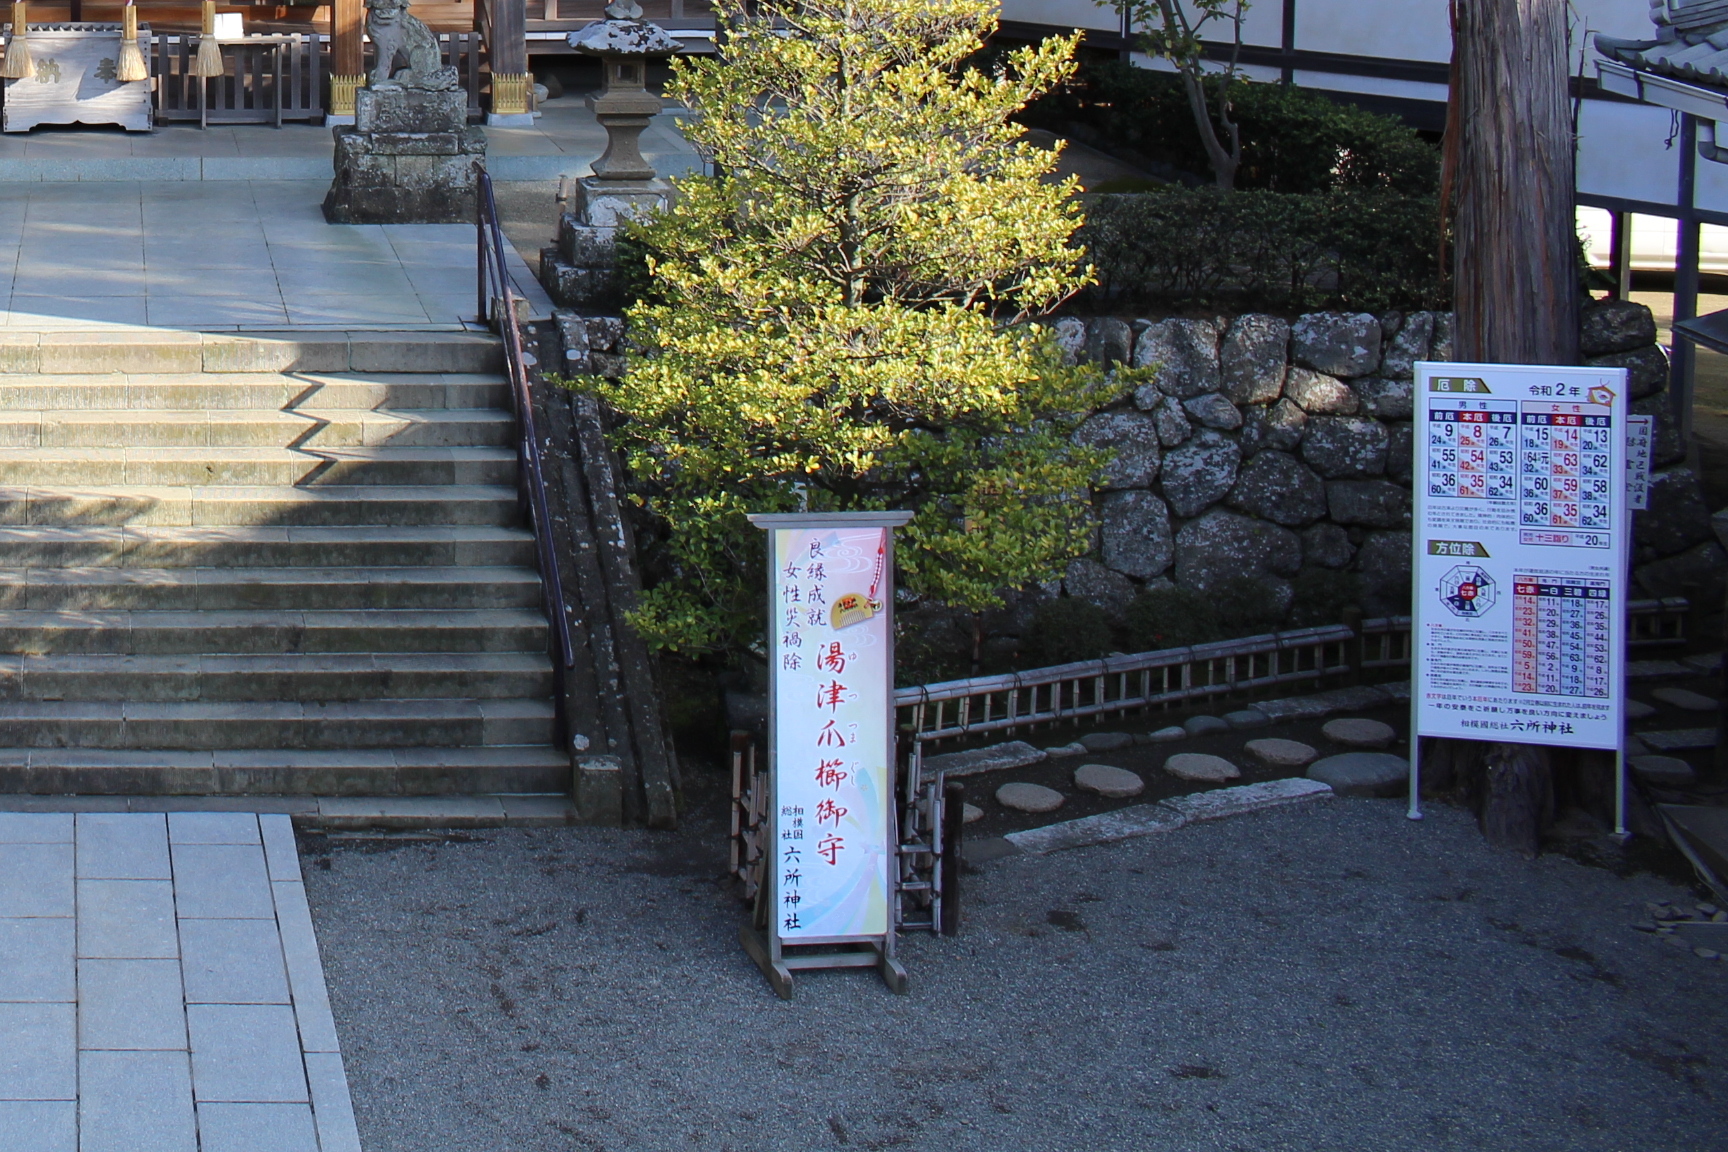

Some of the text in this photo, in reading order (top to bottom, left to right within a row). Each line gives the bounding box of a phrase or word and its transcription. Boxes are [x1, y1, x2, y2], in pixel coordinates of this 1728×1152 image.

[1437, 379, 1476, 392] 厄除
[1529, 382, 1580, 397] 令和2年
[1459, 401, 1487, 410] 男性
[1552, 404, 1580, 412] 女性
[1463, 412, 1483, 422] 本厄
[1555, 416, 1576, 425] 本厄
[1445, 424, 1453, 436] 9
[1474, 425, 1481, 437] 8
[1503, 427, 1511, 439] 7
[1536, 428, 1548, 440] 15
[1565, 429, 1578, 441] 14
[1594, 430, 1607, 442] 13
[1442, 449, 1513, 464] 55 54 53
[1528, 452, 1607, 467] 64 元 63 62
[1442, 474, 1512, 489] 36 35 34
[1535, 477, 1607, 492] 60 59 58
[1534, 502, 1606, 518] 36 35 34
[1436, 541, 1475, 555] 方位除
[1585, 535, 1598, 546] 20
[806, 538, 827, 626] 良縁成就
[1540, 587, 1558, 595] 一白
[782, 561, 803, 671] 女性災禍除
[848, 652, 857, 661] ゆ
[814, 641, 848, 866] 湯津爪櫛御守
[792, 804, 804, 840] 相模国
[783, 845, 802, 932] 六所神社
